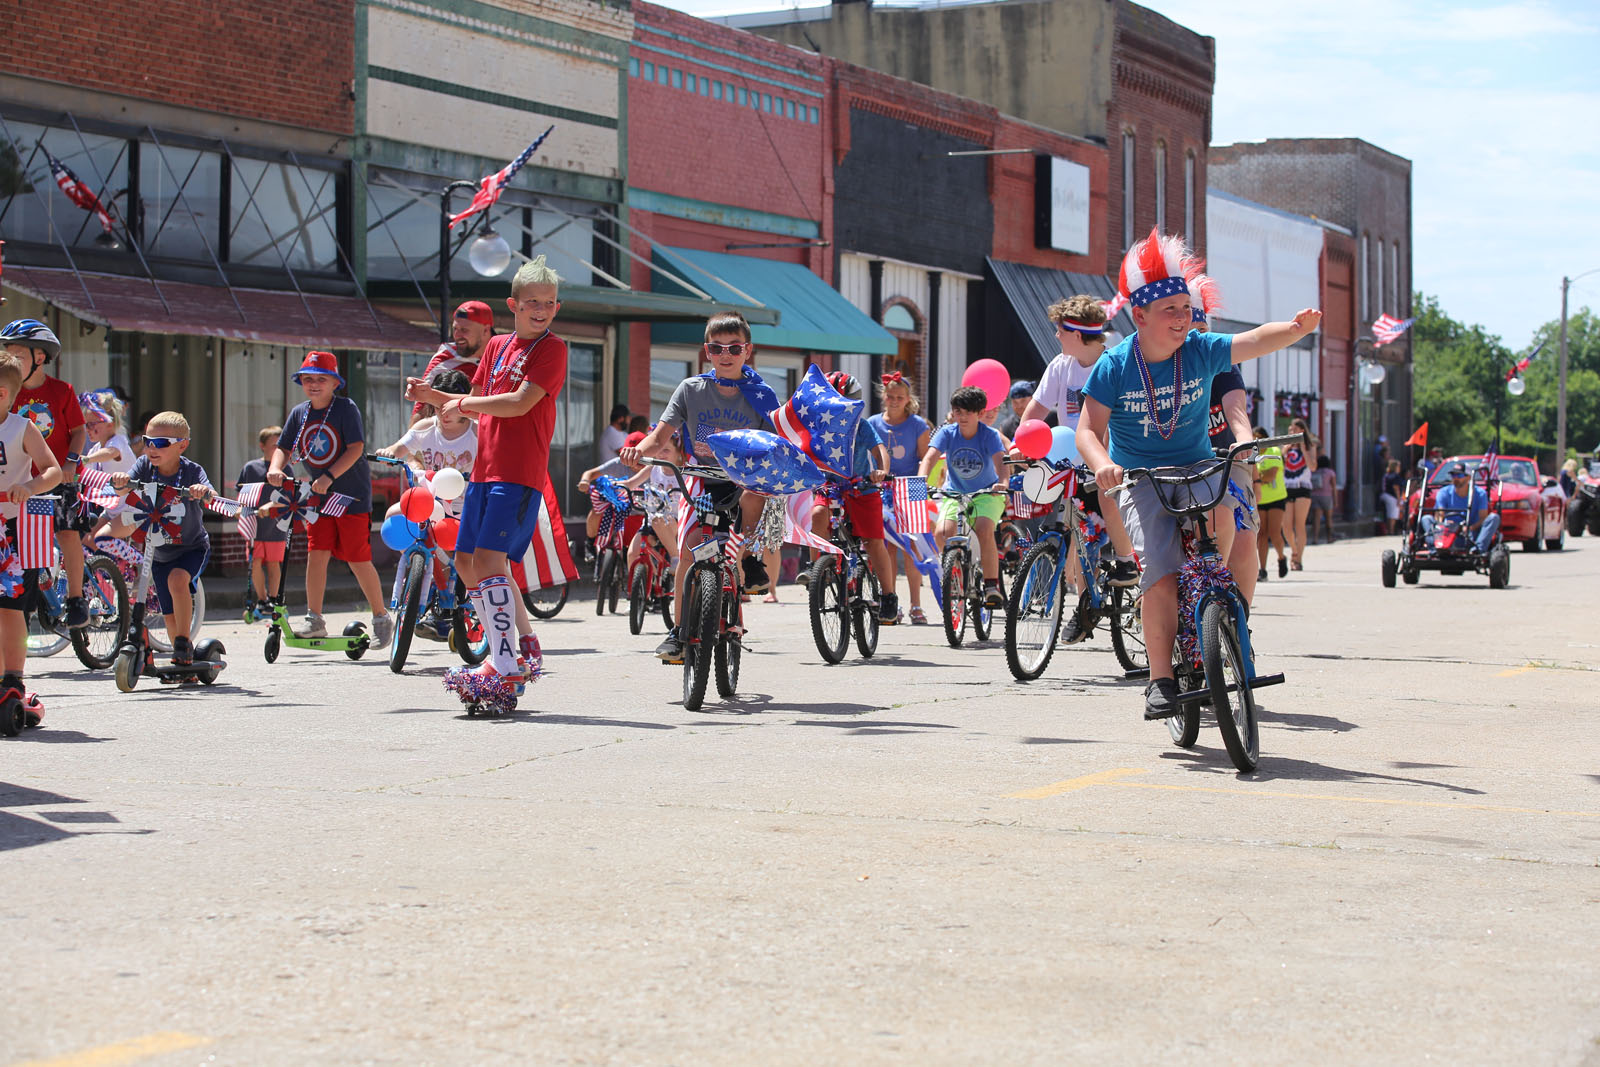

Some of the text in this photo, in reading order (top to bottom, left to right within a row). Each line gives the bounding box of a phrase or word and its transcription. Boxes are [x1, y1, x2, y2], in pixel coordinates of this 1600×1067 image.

[1123, 401, 1149, 412] THE
[697, 407, 752, 427] OLD NAVY
